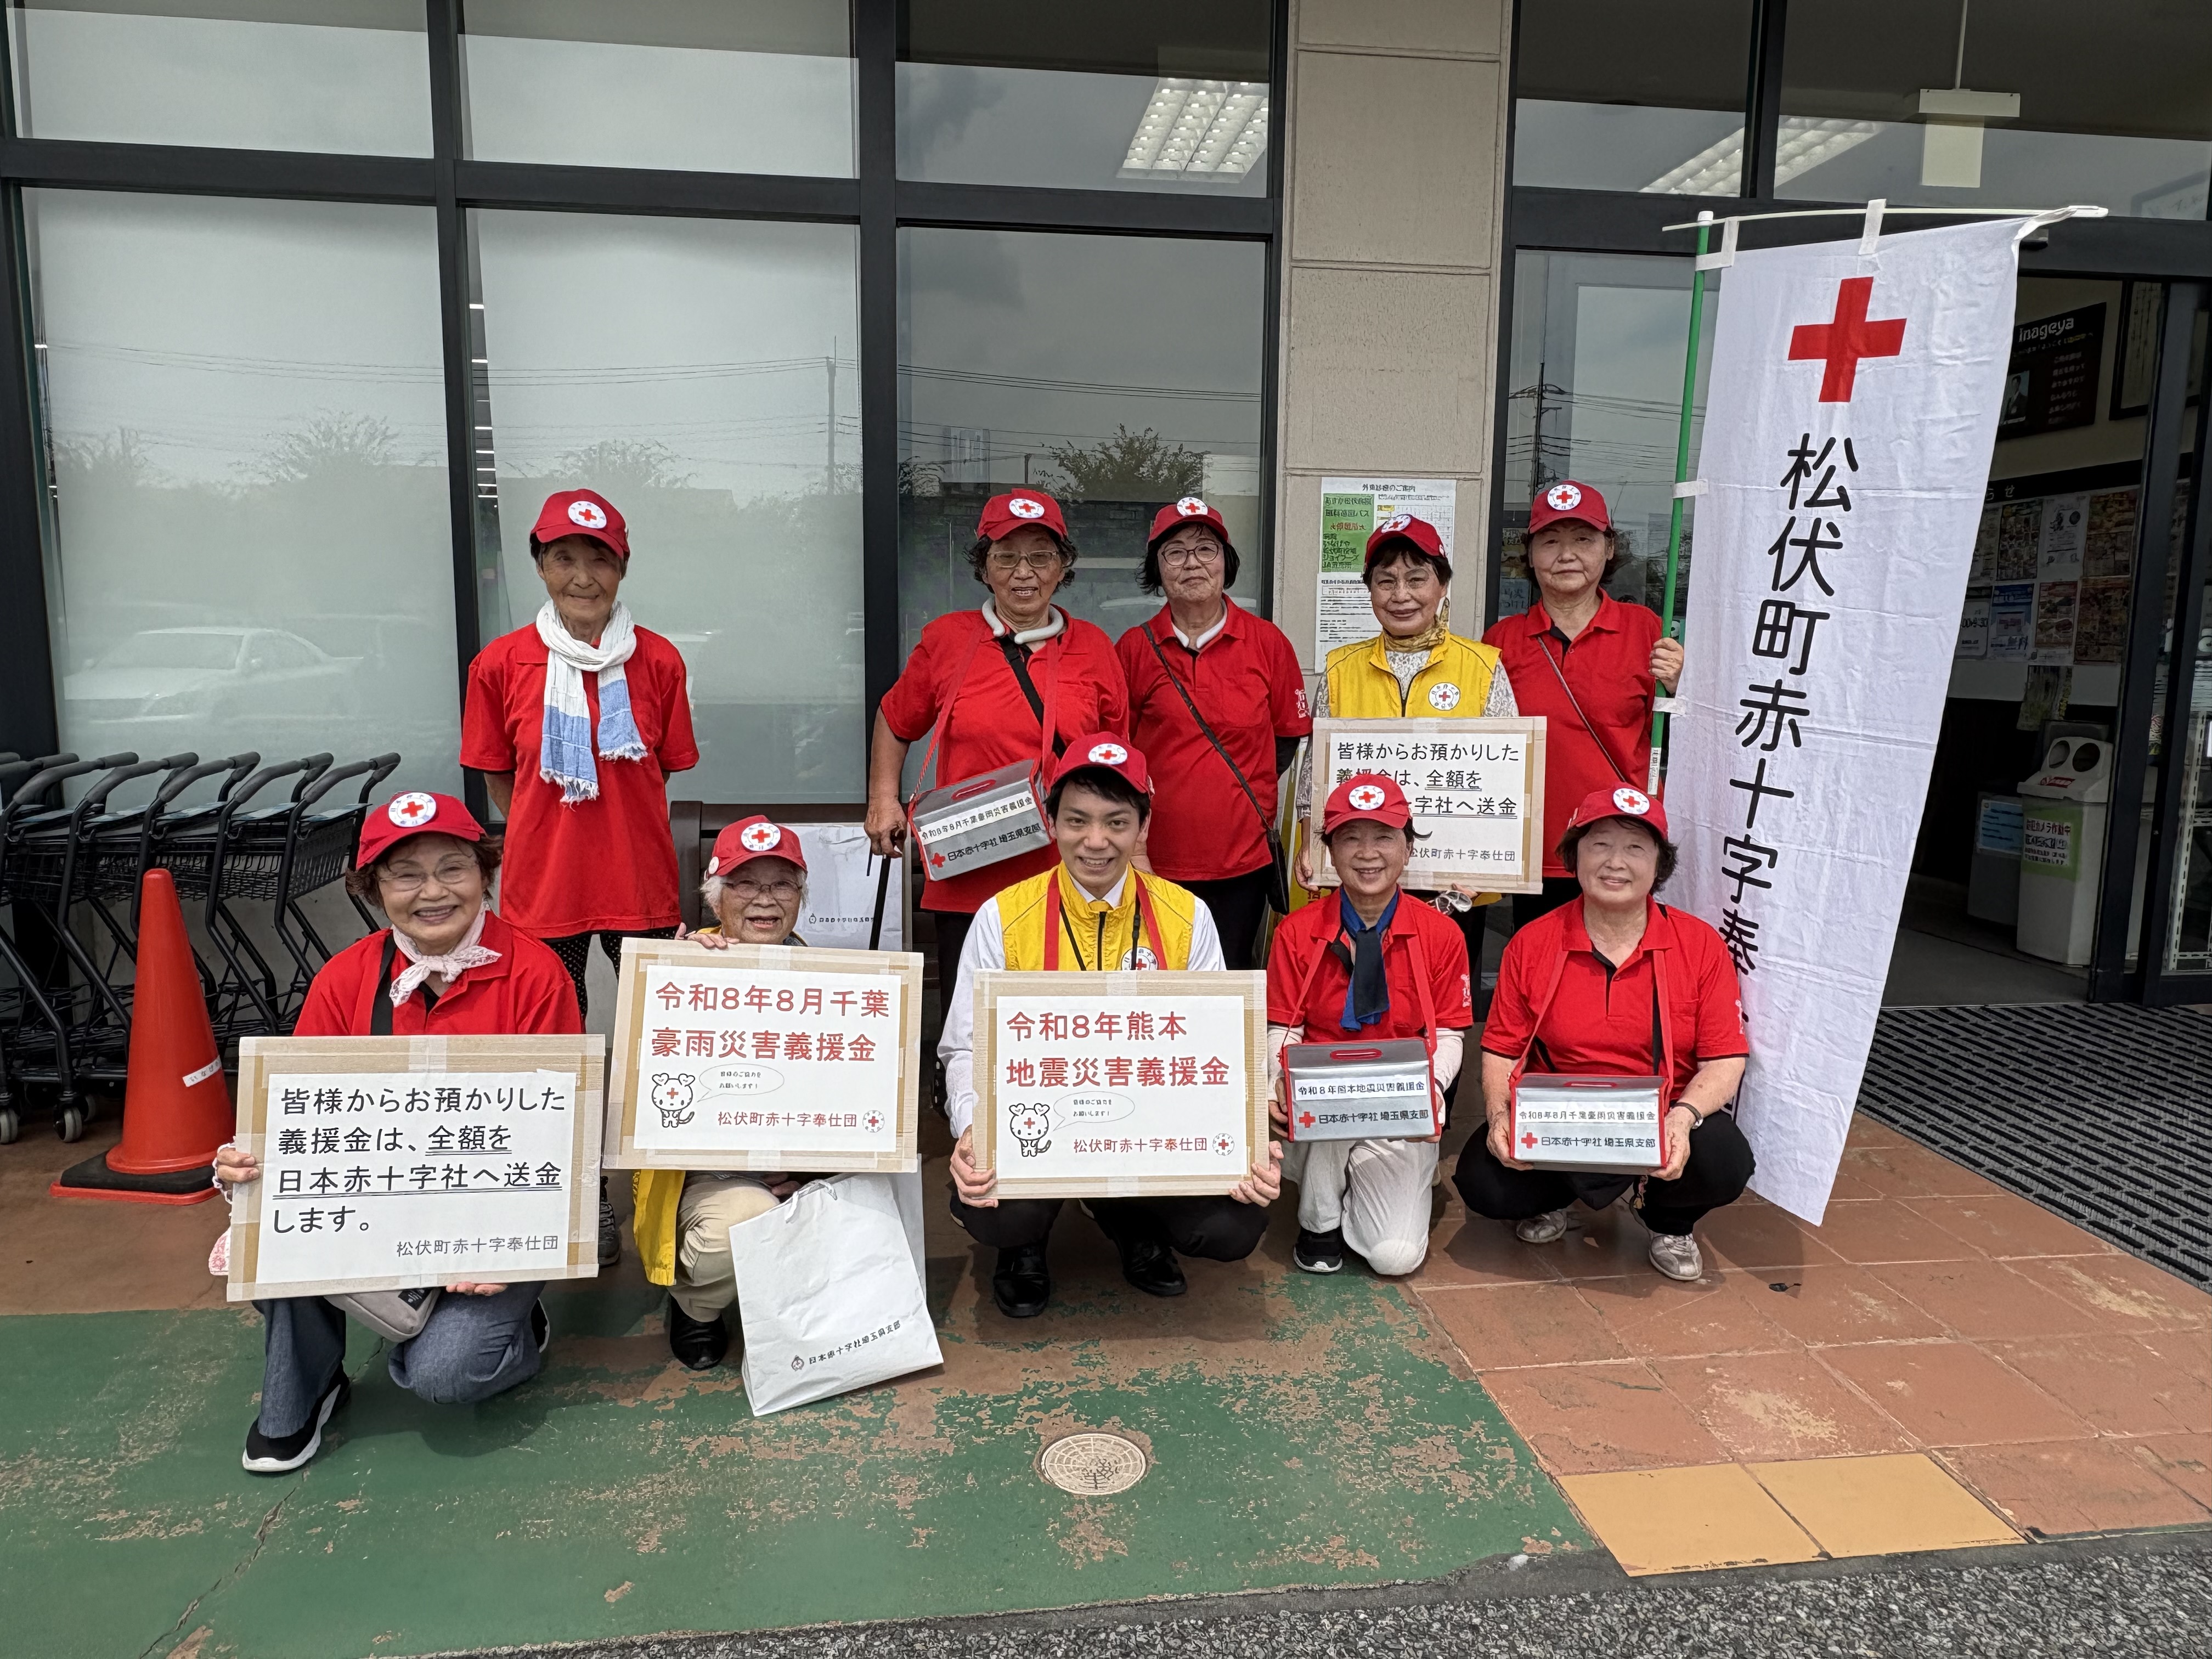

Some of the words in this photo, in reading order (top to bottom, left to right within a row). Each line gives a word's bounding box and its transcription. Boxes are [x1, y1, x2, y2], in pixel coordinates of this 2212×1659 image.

[1718, 433, 1859, 1023] 松伏町赤十字奉
[1337, 742, 1519, 761] 皆様からお預かりした
[1407, 795, 1517, 815] 字社へ送金
[947, 838, 998, 861] 日本赤十字社
[656, 982, 889, 1018] 令和8年8月千葉
[1006, 1012, 1187, 1041] 令和8年熊本
[652, 1027, 876, 1062] 豪雨災害義援金
[1006, 1056, 1229, 1087] 地震災害義援金
[281, 1087, 565, 1115] 皆様からお預かりした
[718, 1111, 857, 1127] 松伏町赤十字奉仕団
[1319, 1113, 1378, 1125] 日本赤十字社
[278, 1125, 511, 1154] 義援金は、全額を
[1074, 1137, 1207, 1153] 松伏町赤十字奉仕団
[1541, 1137, 1602, 1147] 日本赤十字社
[1604, 1138, 1656, 1148] 埼玉県支部
[278, 1162, 562, 1194] 日本赤十字社へ送金
[273, 1206, 370, 1234] します。
[397, 1235, 558, 1257] 松伏町赤十字奉仕団
